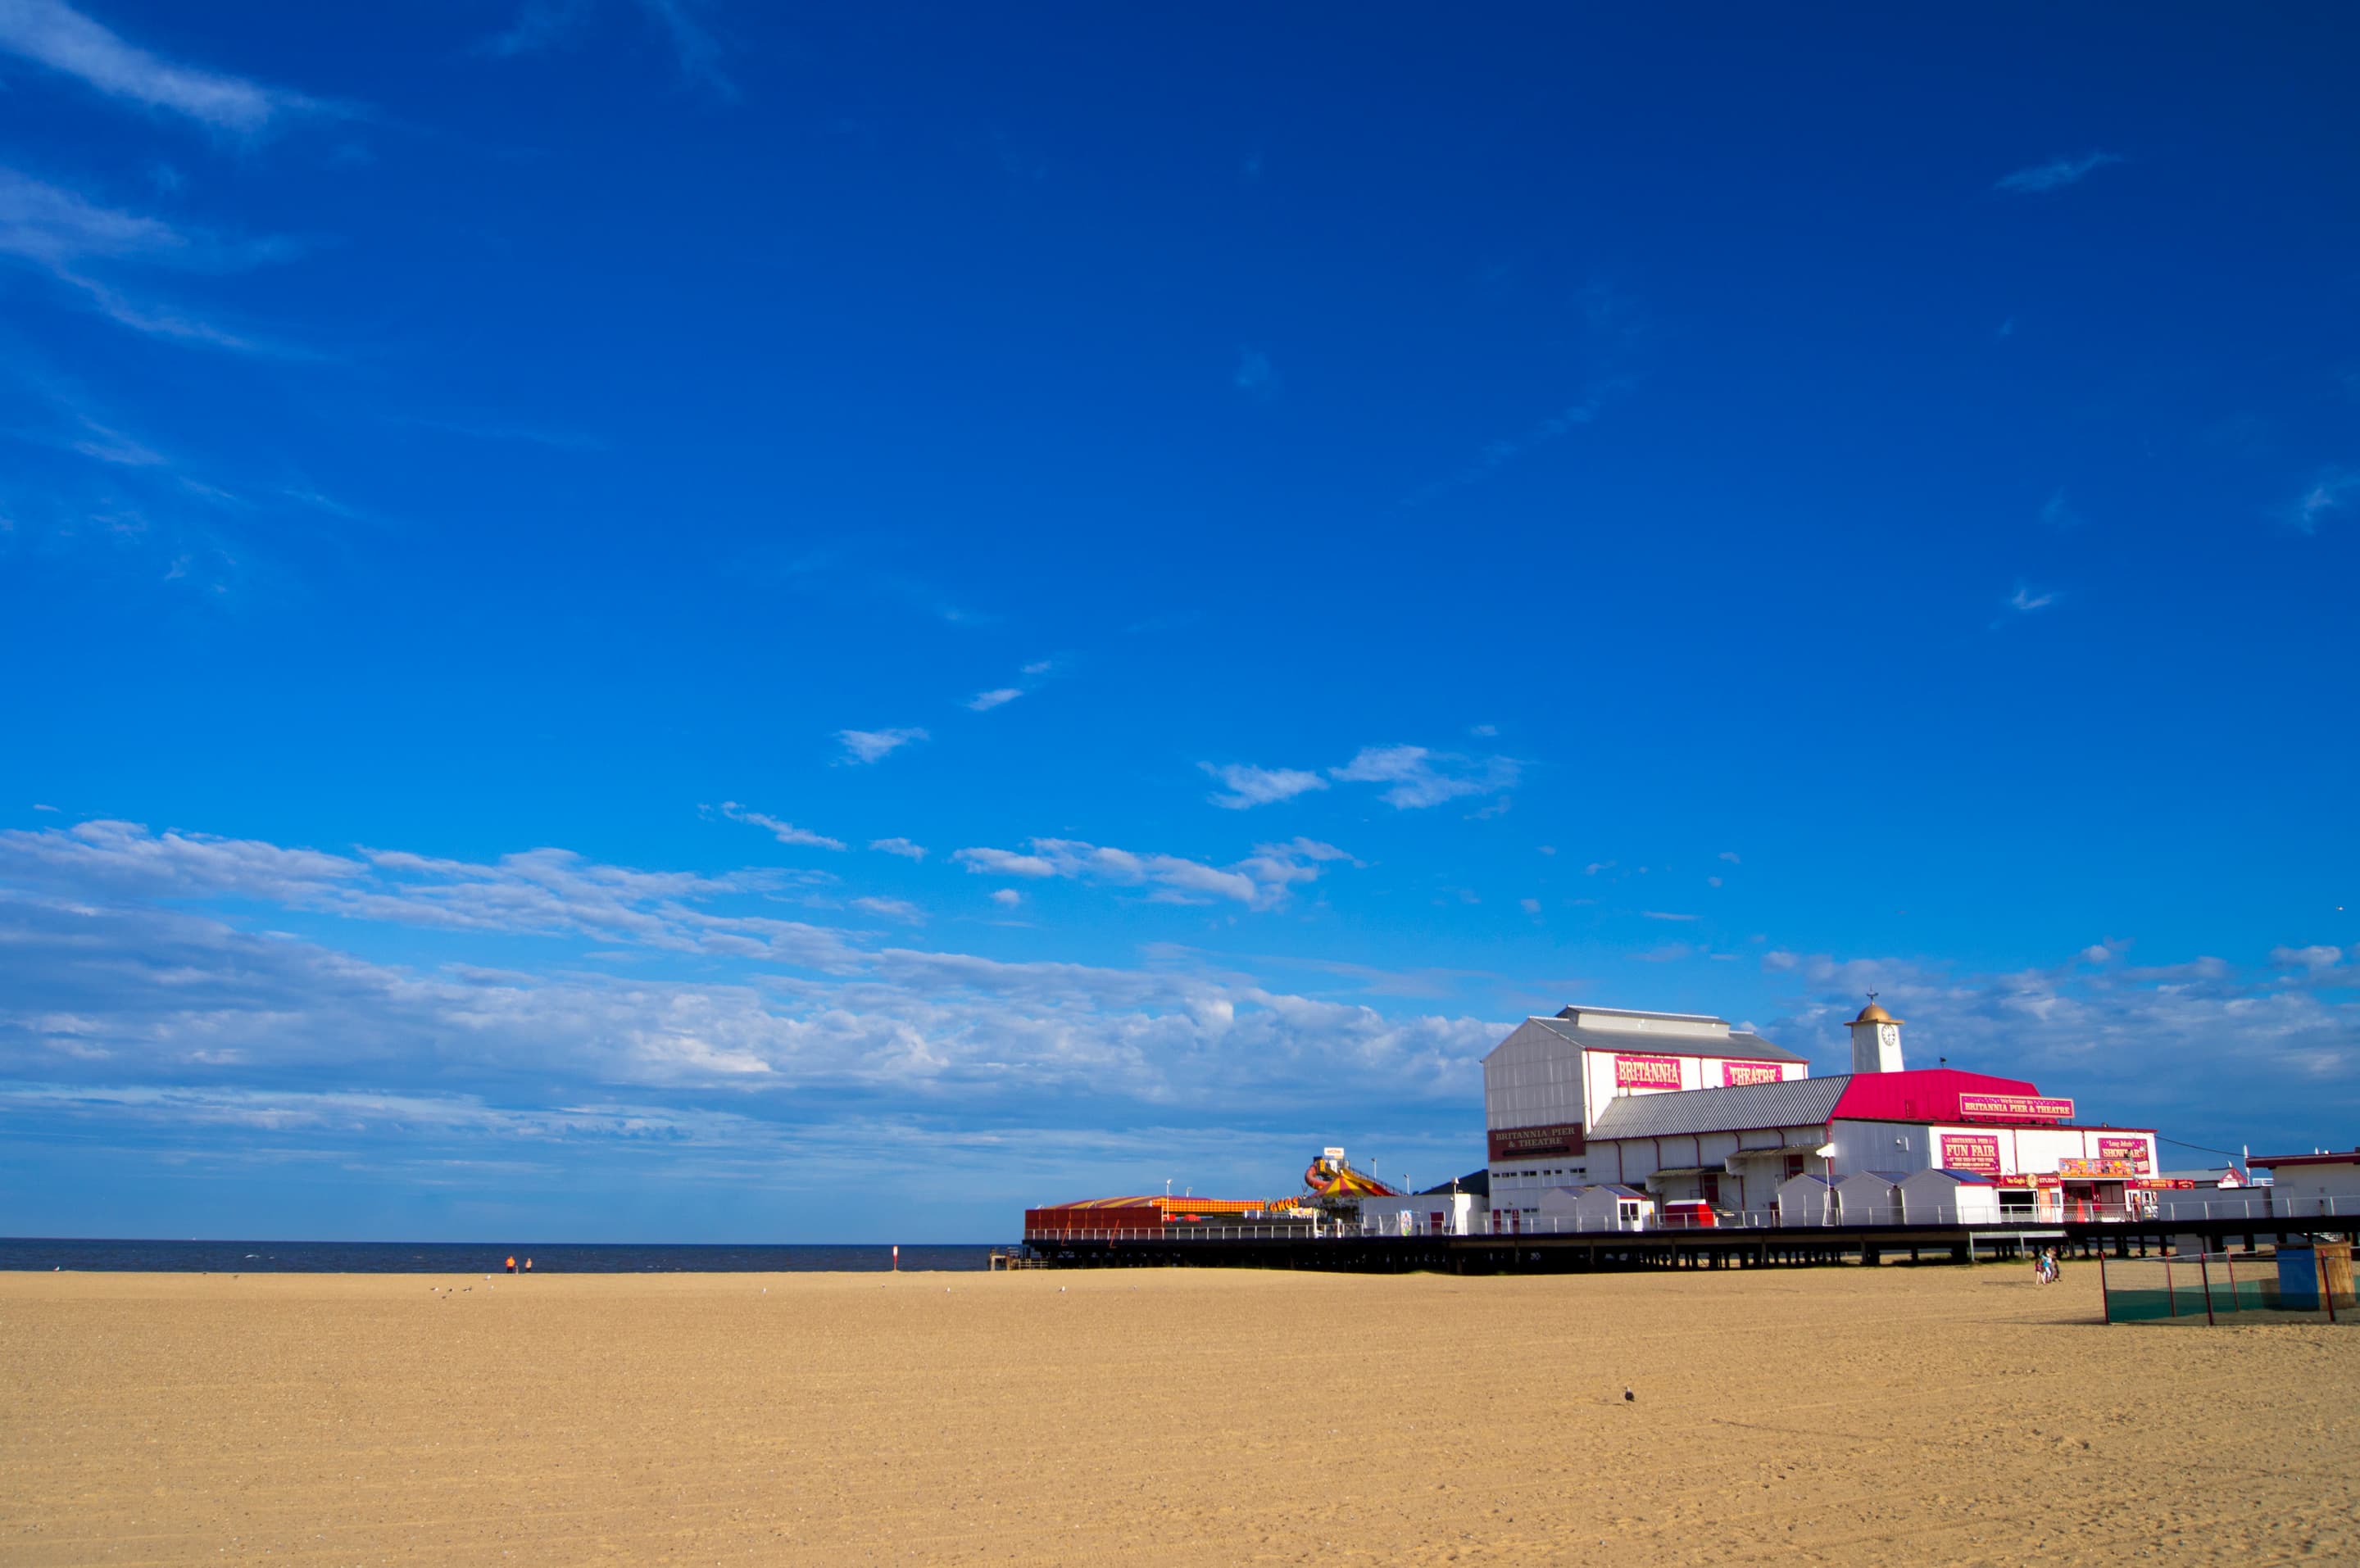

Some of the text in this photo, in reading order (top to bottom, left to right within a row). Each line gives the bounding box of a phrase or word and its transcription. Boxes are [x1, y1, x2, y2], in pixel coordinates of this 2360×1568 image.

[1618, 1060, 1680, 1085] BRITANNIA
[1728, 1066, 1777, 1085] THEATRE
[1964, 1102, 2008, 1112] BRITANNIA
[2010, 1104, 2028, 1113] PIER
[2036, 1105, 2070, 1114] THEATRE
[1495, 1127, 1575, 1140] BRITANNIA PIER
[1519, 1137, 1563, 1147] THEATRE
[1945, 1144, 1995, 1157] FUN FAIR
